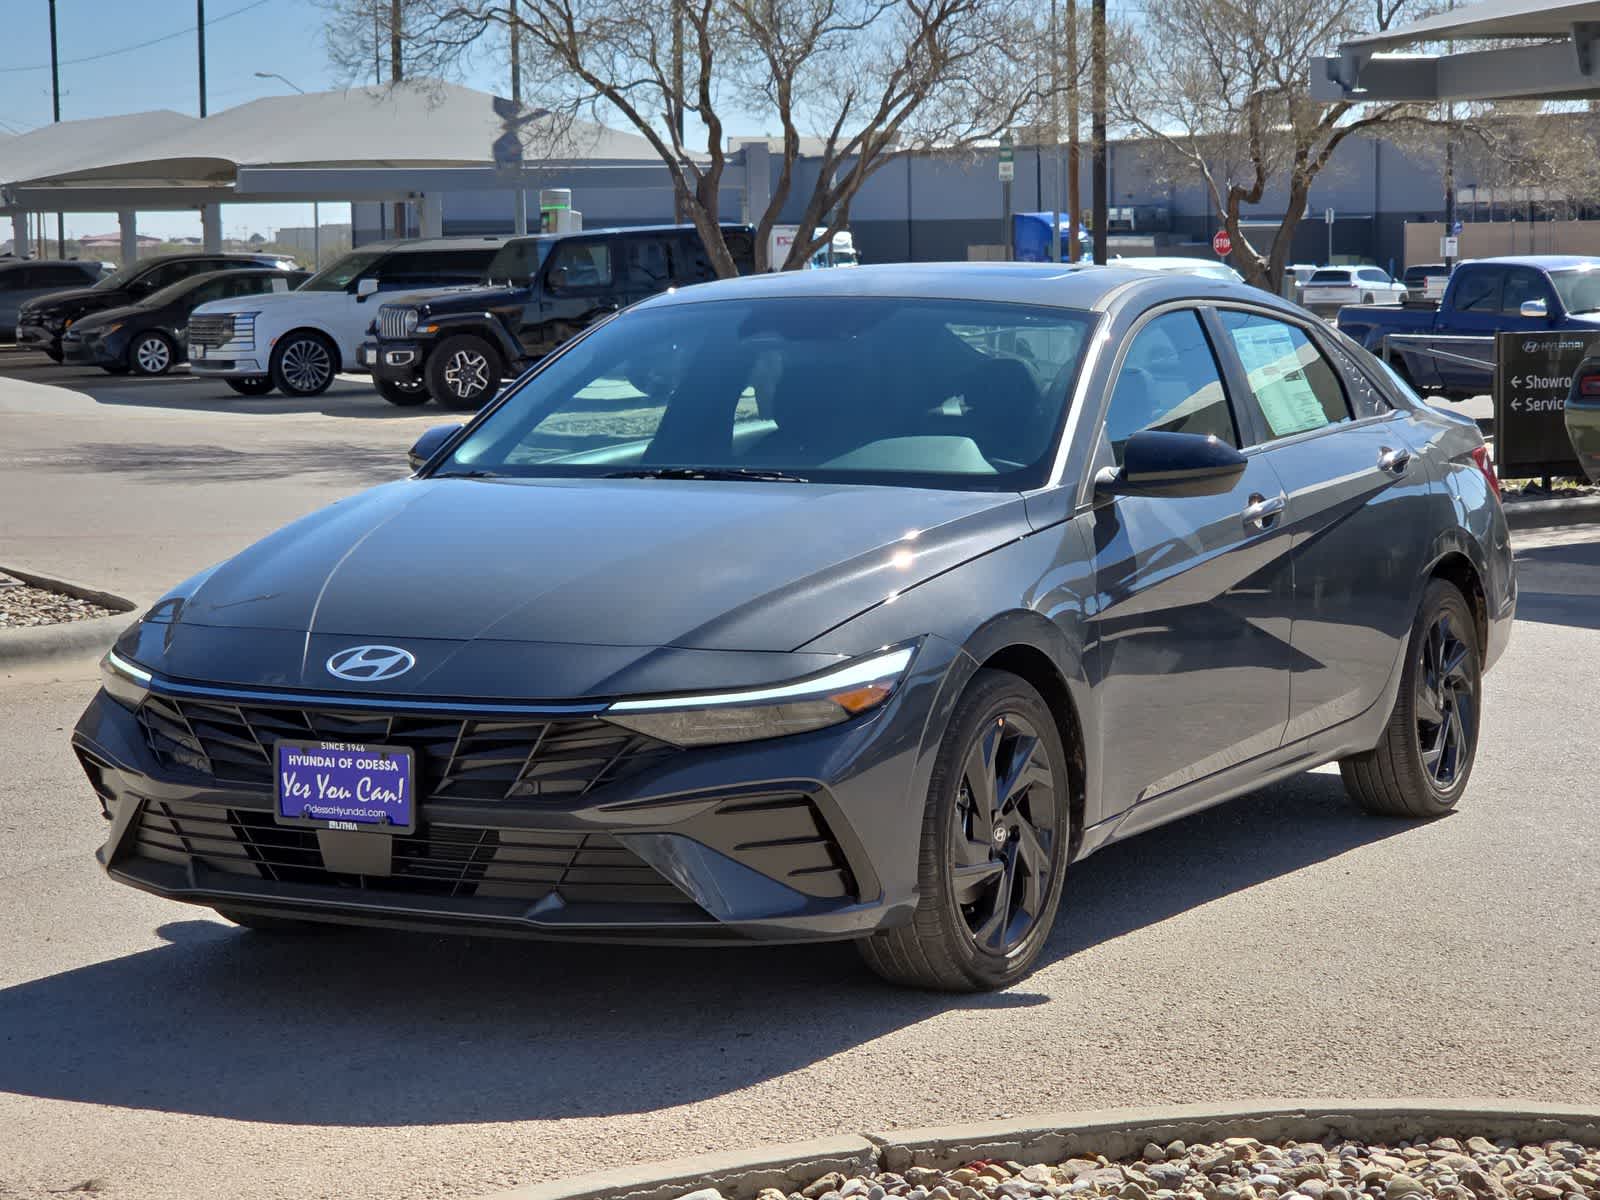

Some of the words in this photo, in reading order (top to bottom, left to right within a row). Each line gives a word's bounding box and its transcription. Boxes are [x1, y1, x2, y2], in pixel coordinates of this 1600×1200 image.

[1215, 238, 1231, 249] STOP
[320, 742, 345, 751] SINCE
[346, 744, 366, 752] 1946
[288, 755, 335, 768] HYUNDAI
[338, 757, 353, 769] OF
[356, 759, 399, 772] ODESSA
[282, 771, 312, 799] Yes
[316, 774, 352, 799] You
[356, 777, 404, 803] Can!
[304, 803, 387, 817] OdessaHyundai.com
